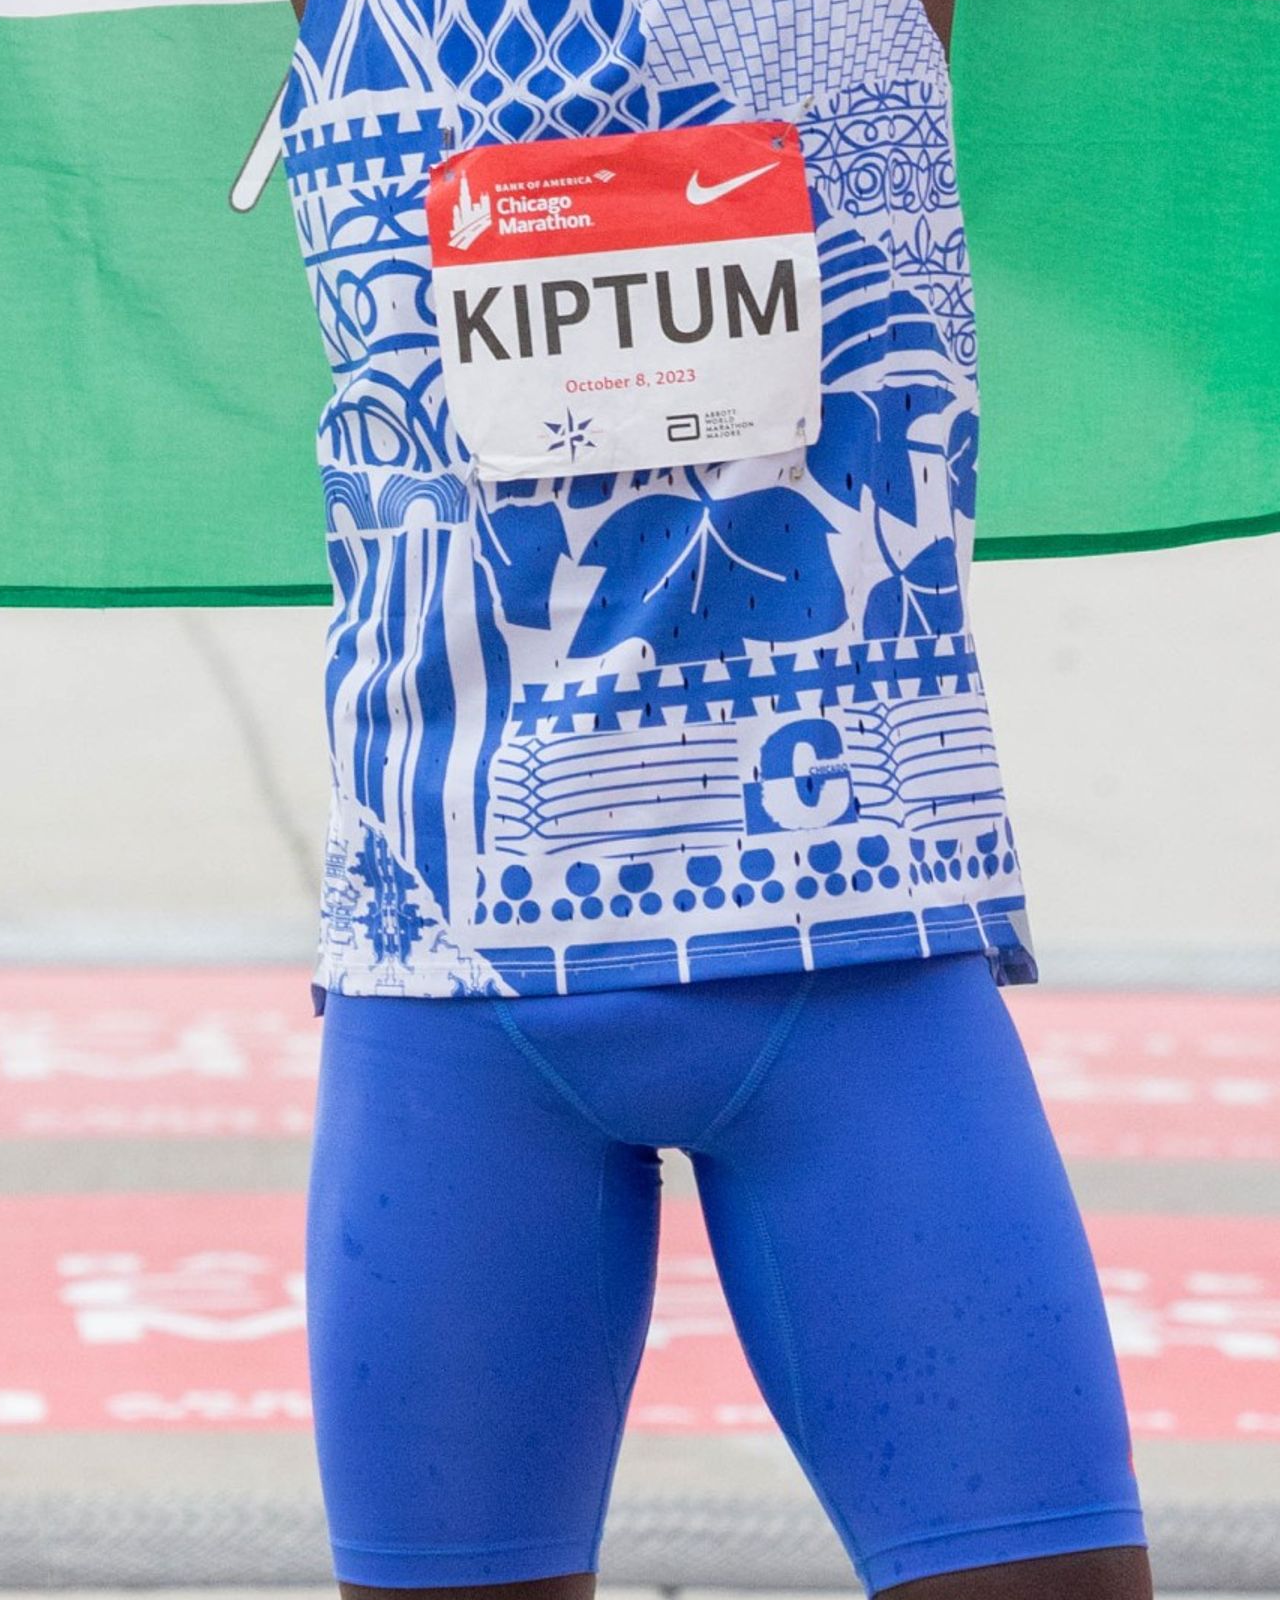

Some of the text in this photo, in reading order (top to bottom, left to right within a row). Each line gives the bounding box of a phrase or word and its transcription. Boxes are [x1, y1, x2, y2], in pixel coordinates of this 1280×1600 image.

[495, 176, 592, 193] BANK OF AMERICA
[497, 196, 572, 214] Chicago
[498, 213, 592, 236] Marathon
[452, 258, 800, 364] KIPTUM
[565, 369, 697, 393] October 8, 2023
[706, 422, 754, 431] MARATHON
